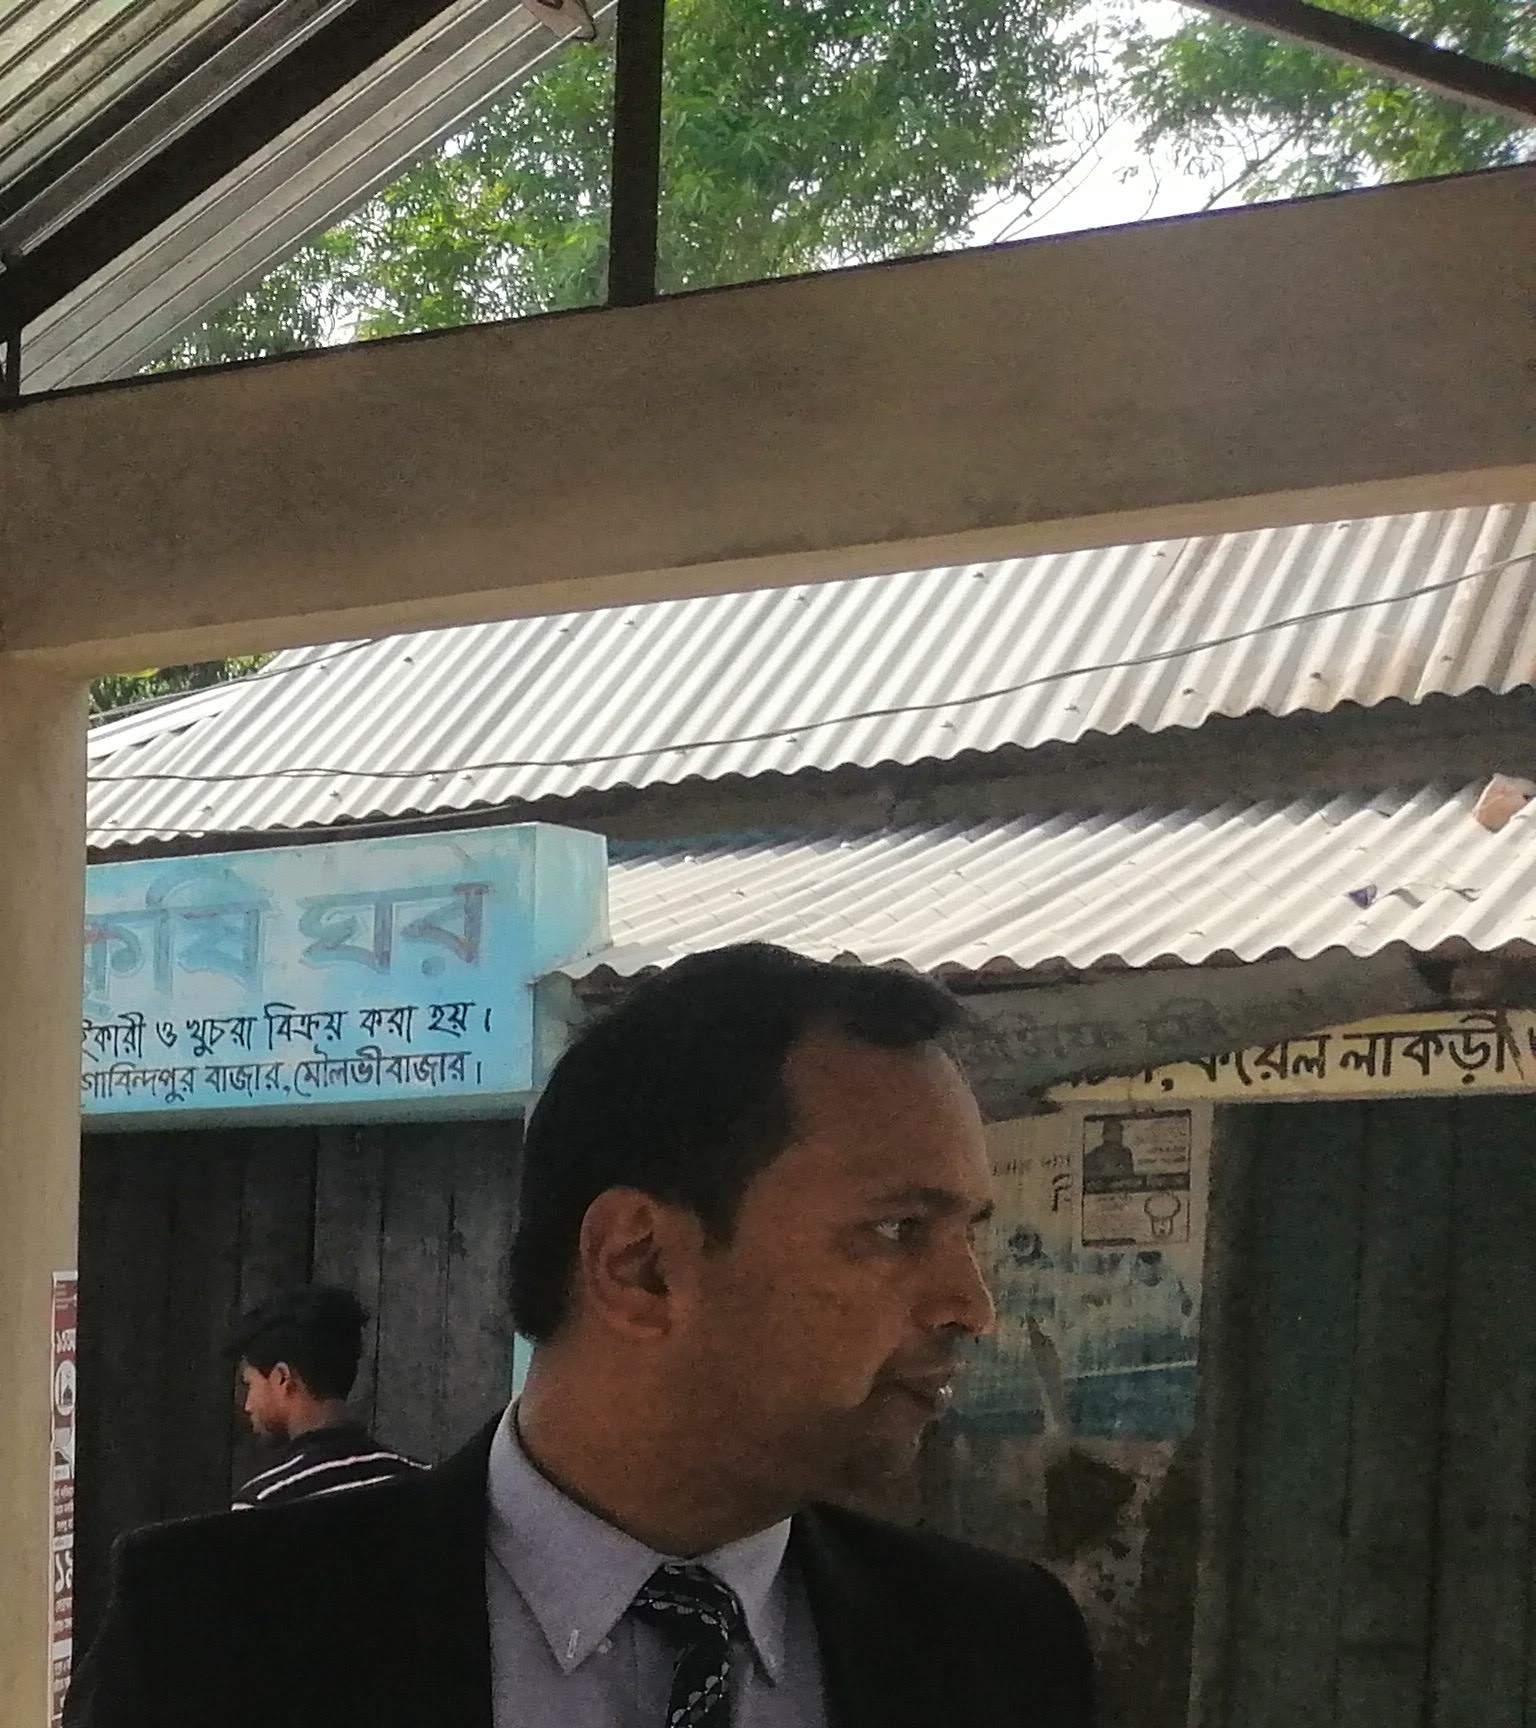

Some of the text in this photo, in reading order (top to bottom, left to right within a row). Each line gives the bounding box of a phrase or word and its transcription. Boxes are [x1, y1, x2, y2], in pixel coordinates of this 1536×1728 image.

[297, 883, 492, 975] ঘর
[156, 1020, 178, 1048] ও
[187, 1016, 257, 1057] খুচরা
[264, 1002, 347, 1051] বিক্রয়
[359, 1006, 418, 1044] করা
